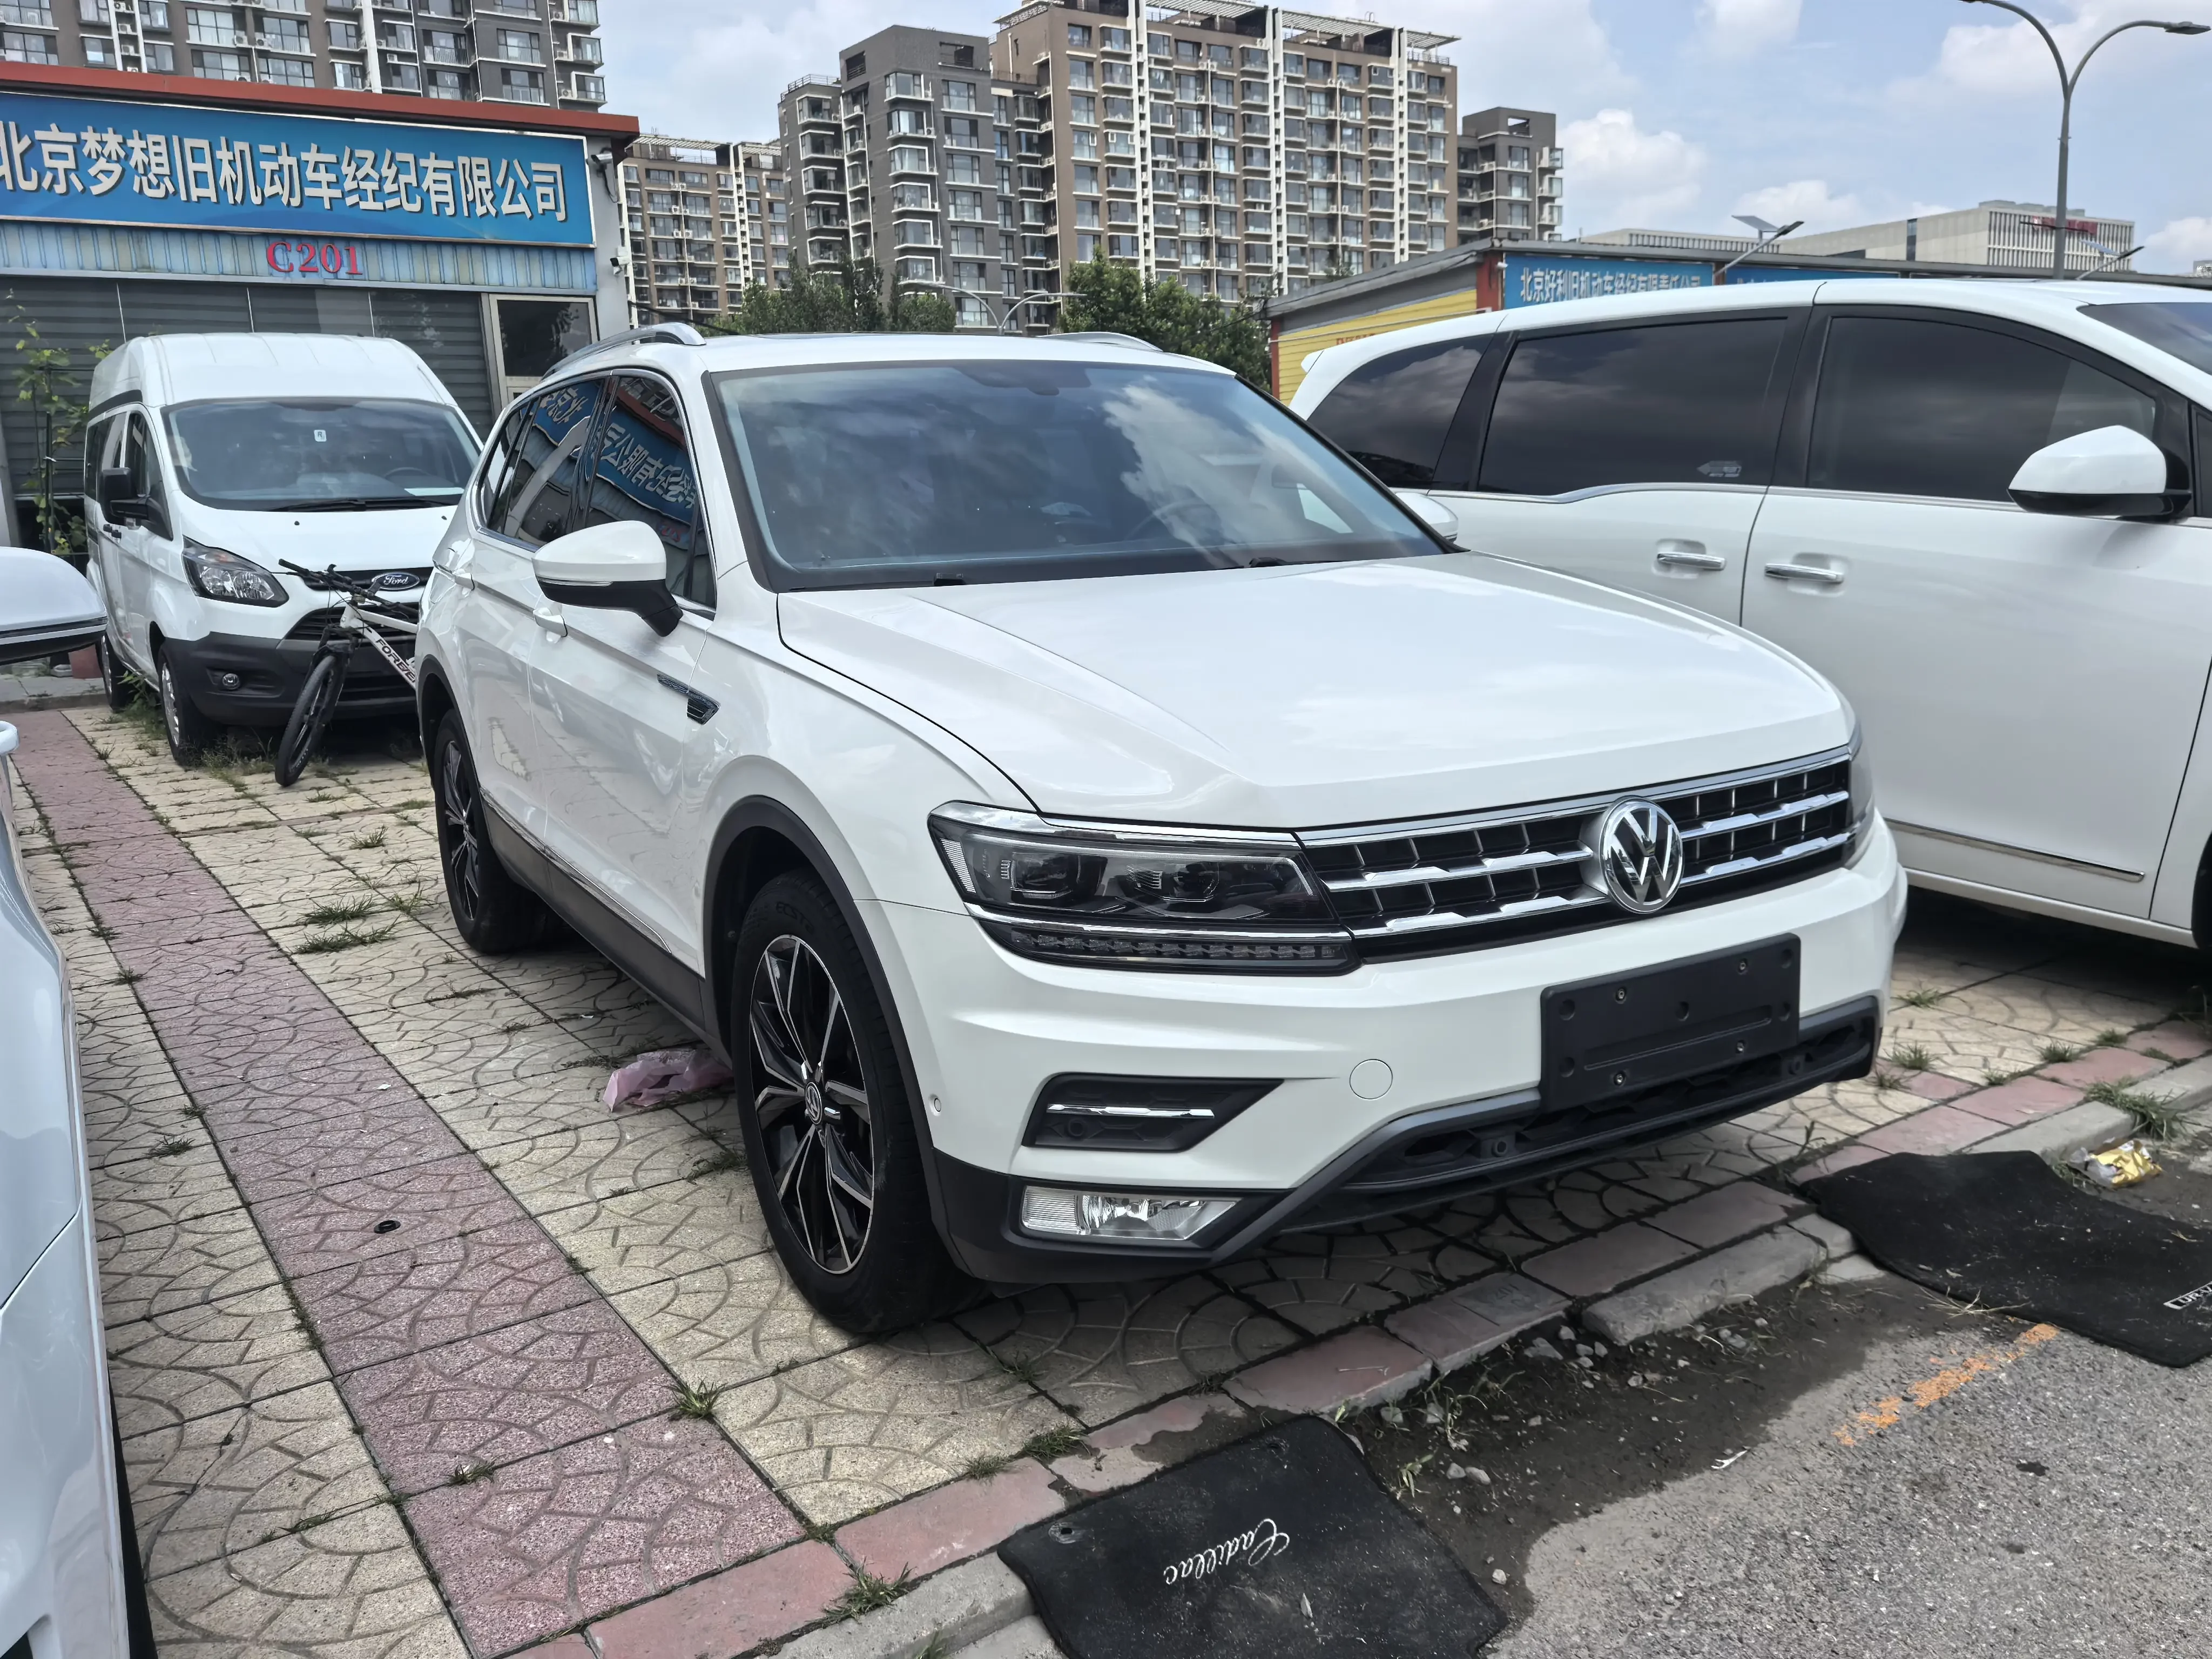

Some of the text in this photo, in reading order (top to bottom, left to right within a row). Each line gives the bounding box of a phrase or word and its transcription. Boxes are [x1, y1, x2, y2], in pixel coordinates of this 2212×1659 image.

[0, 120, 567, 222] 北京梦想旧机动车经纪有限公司
[266, 241, 364, 275] C201
[375, 638, 415, 683] FOREVE
[1163, 1518, 1290, 1585] Cadillac
